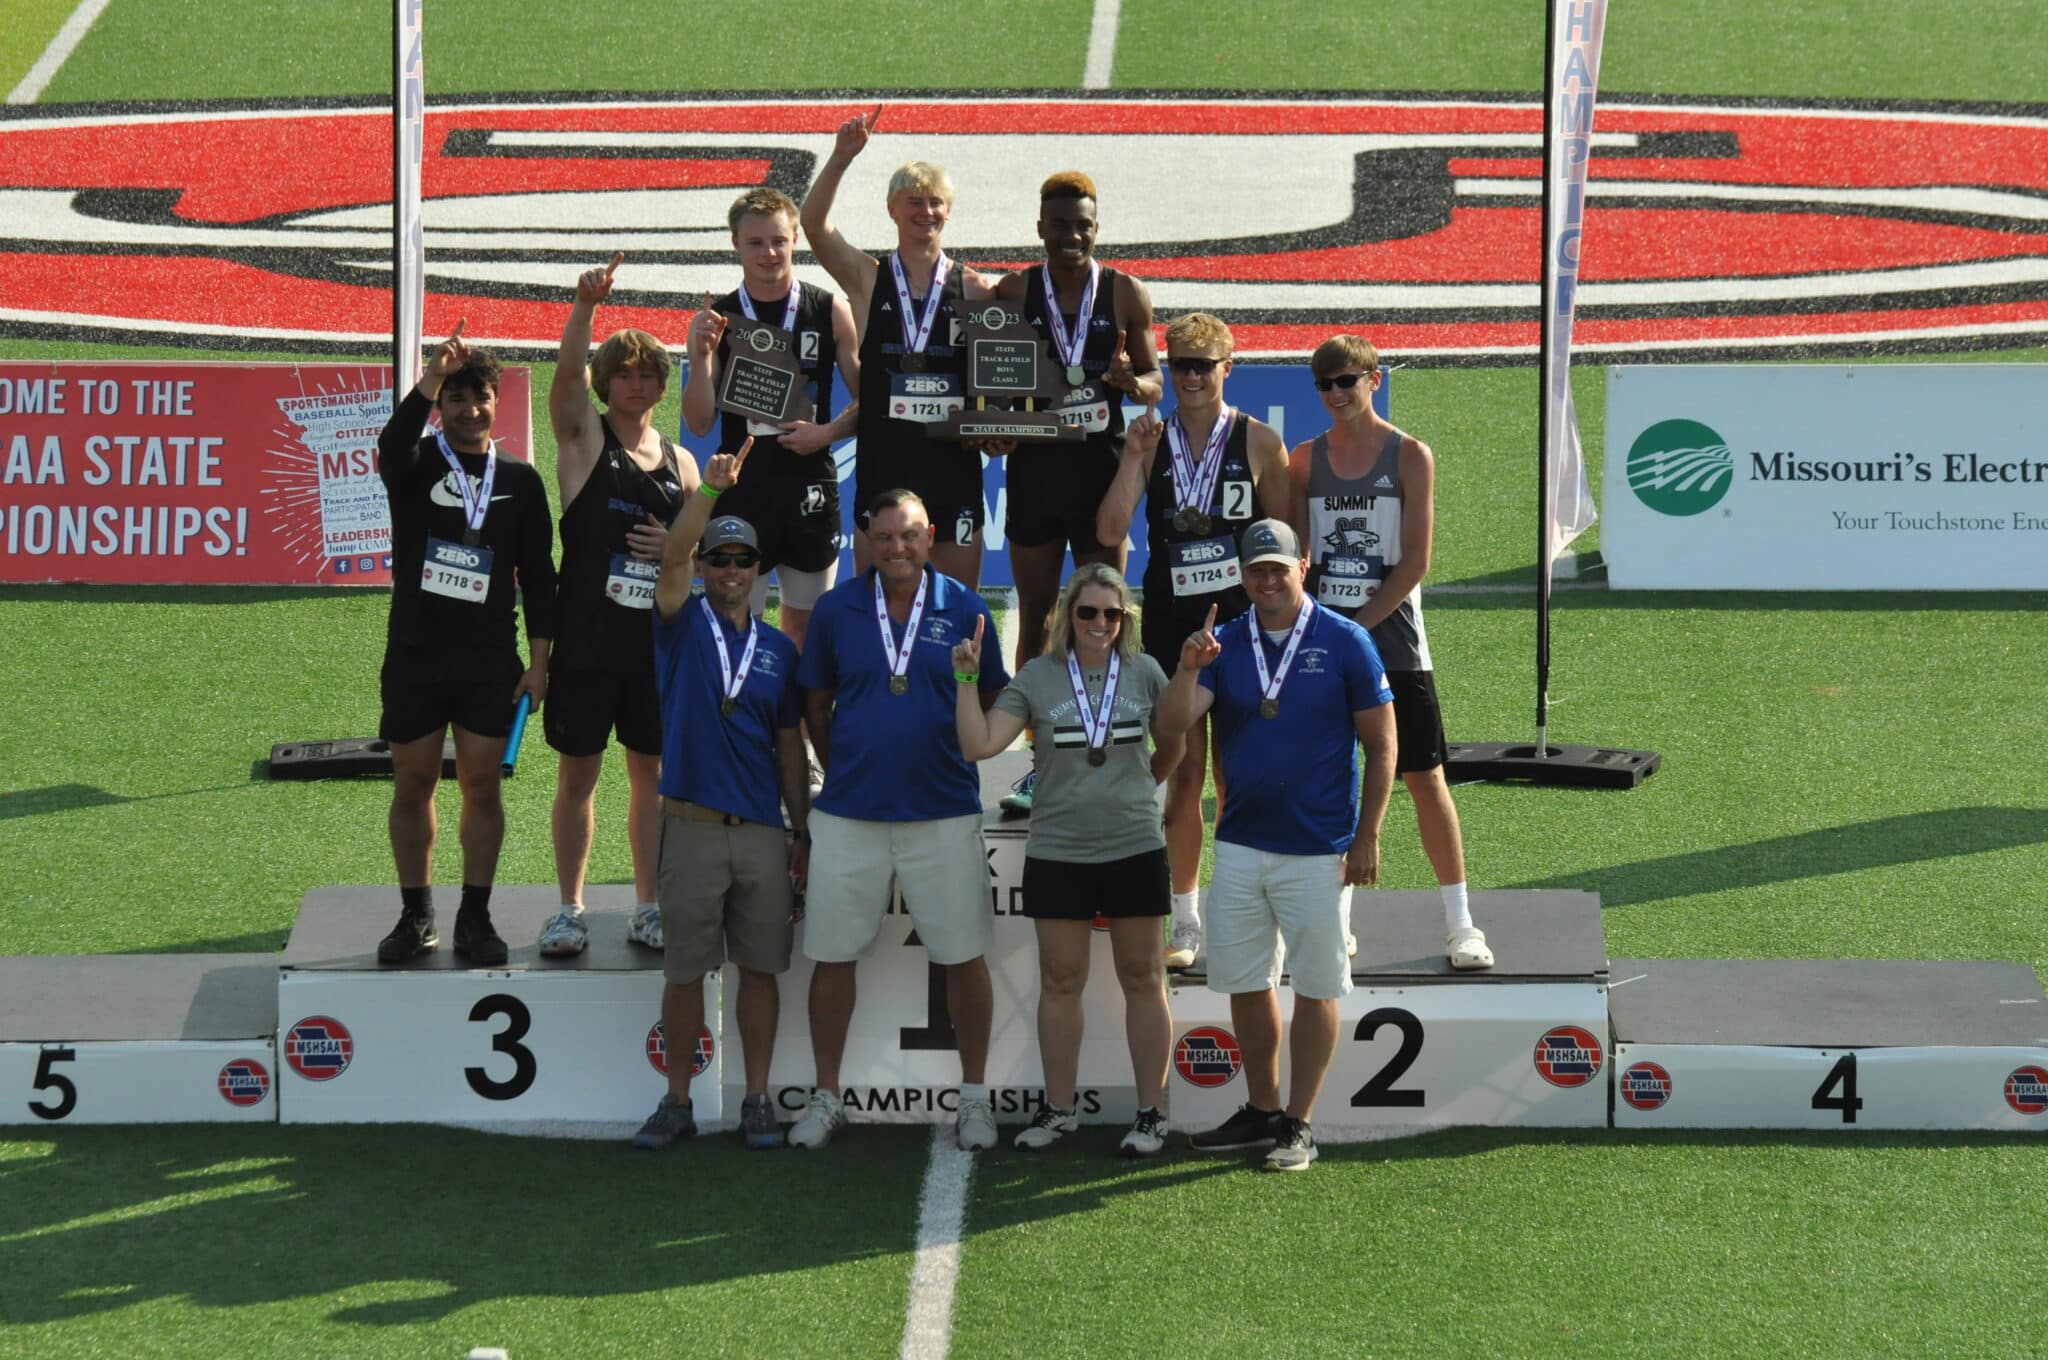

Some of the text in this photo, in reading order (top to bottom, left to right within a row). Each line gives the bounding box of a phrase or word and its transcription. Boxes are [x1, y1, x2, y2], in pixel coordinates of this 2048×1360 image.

[805, 333, 817, 358] 2
[904, 379, 949, 393] ZERO
[78, 380, 119, 415] TO
[131, 380, 194, 416] THE
[283, 391, 381, 412] SPORTSMANSHIP
[294, 404, 391, 421] BASEBALL Sports
[912, 403, 941, 415] 1721
[1063, 410, 1092, 424] 1719
[83, 435, 224, 486] STATE
[1749, 452, 1932, 483] Missouri’s
[811, 486, 822, 510] 2
[1229, 484, 1245, 517] 2
[1324, 496, 1377, 511] SUMMIT
[359, 511, 382, 521] BAND
[1832, 511, 1878, 531] Your
[1884, 511, 2005, 531] Touchstone
[961, 520, 971, 544] 2
[435, 546, 480, 567] ZERO
[1181, 544, 1225, 562] ZERO
[1192, 568, 1222, 583] 1724
[1328, 560, 1369, 575] ZERO
[438, 571, 469, 589] 1718
[629, 585, 655, 599] 1720
[1330, 584, 1361, 597] 1723
[297, 1041, 341, 1054] MSHSAA
[464, 993, 536, 1100] 3
[1546, 1048, 1590, 1062] MSHSAA
[1186, 1051, 1230, 1063] MSHSAA
[1351, 1007, 1425, 1107] 2
[28, 1049, 77, 1120] 5
[227, 1075, 261, 1088] MSHSAA
[1629, 1080, 1663, 1091] MSHSAA
[1811, 1055, 1864, 1123] 4
[2013, 1083, 2047, 1094] MSHSAA
